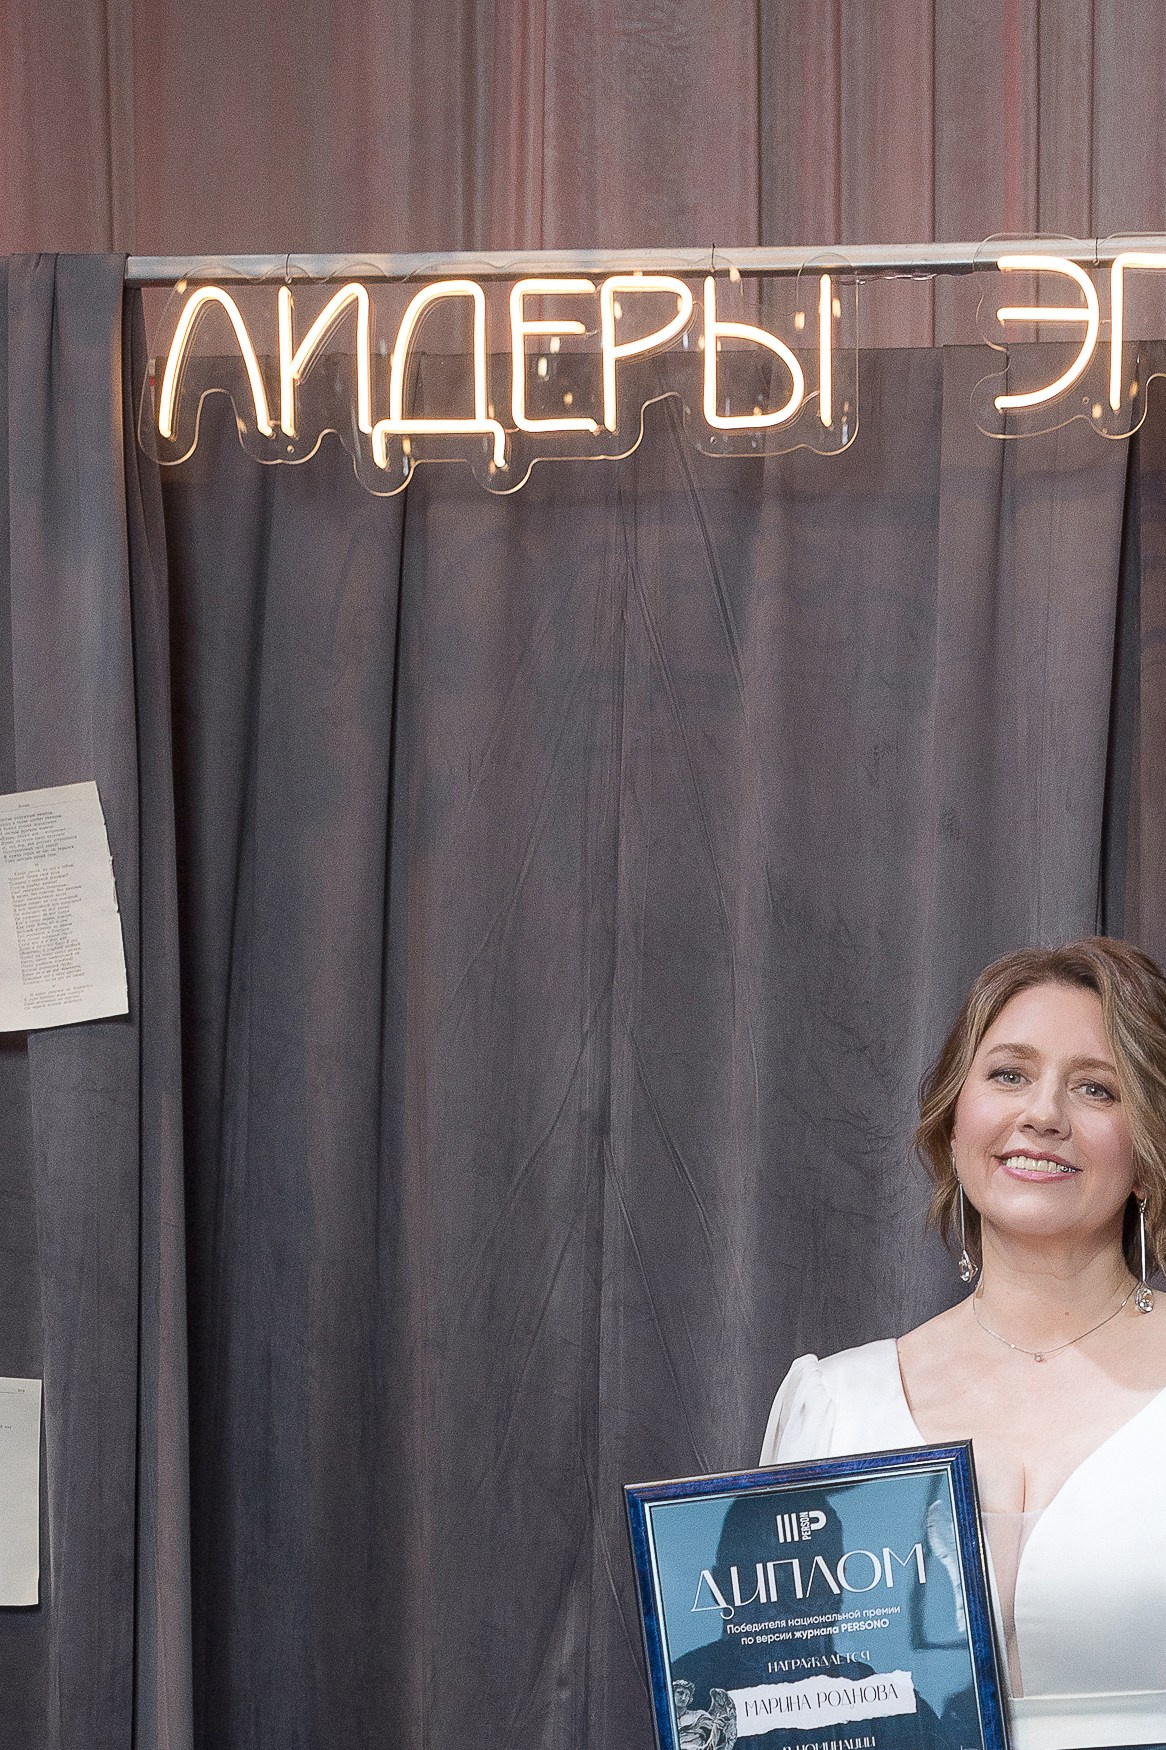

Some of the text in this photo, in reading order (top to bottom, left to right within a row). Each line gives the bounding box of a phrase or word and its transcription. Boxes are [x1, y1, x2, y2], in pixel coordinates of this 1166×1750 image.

[159, 274, 831, 469] ЛИДЕРЫ
[799, 1511, 811, 1540] PERSON
[690, 1543, 926, 1619] ДИПЛОМ
[727, 1605, 901, 1635] Победителя национальной премии
[741, 1618, 889, 1645] по версии журнала PERSONO
[744, 1683, 898, 1717] МАРИНА РОДНОВА
